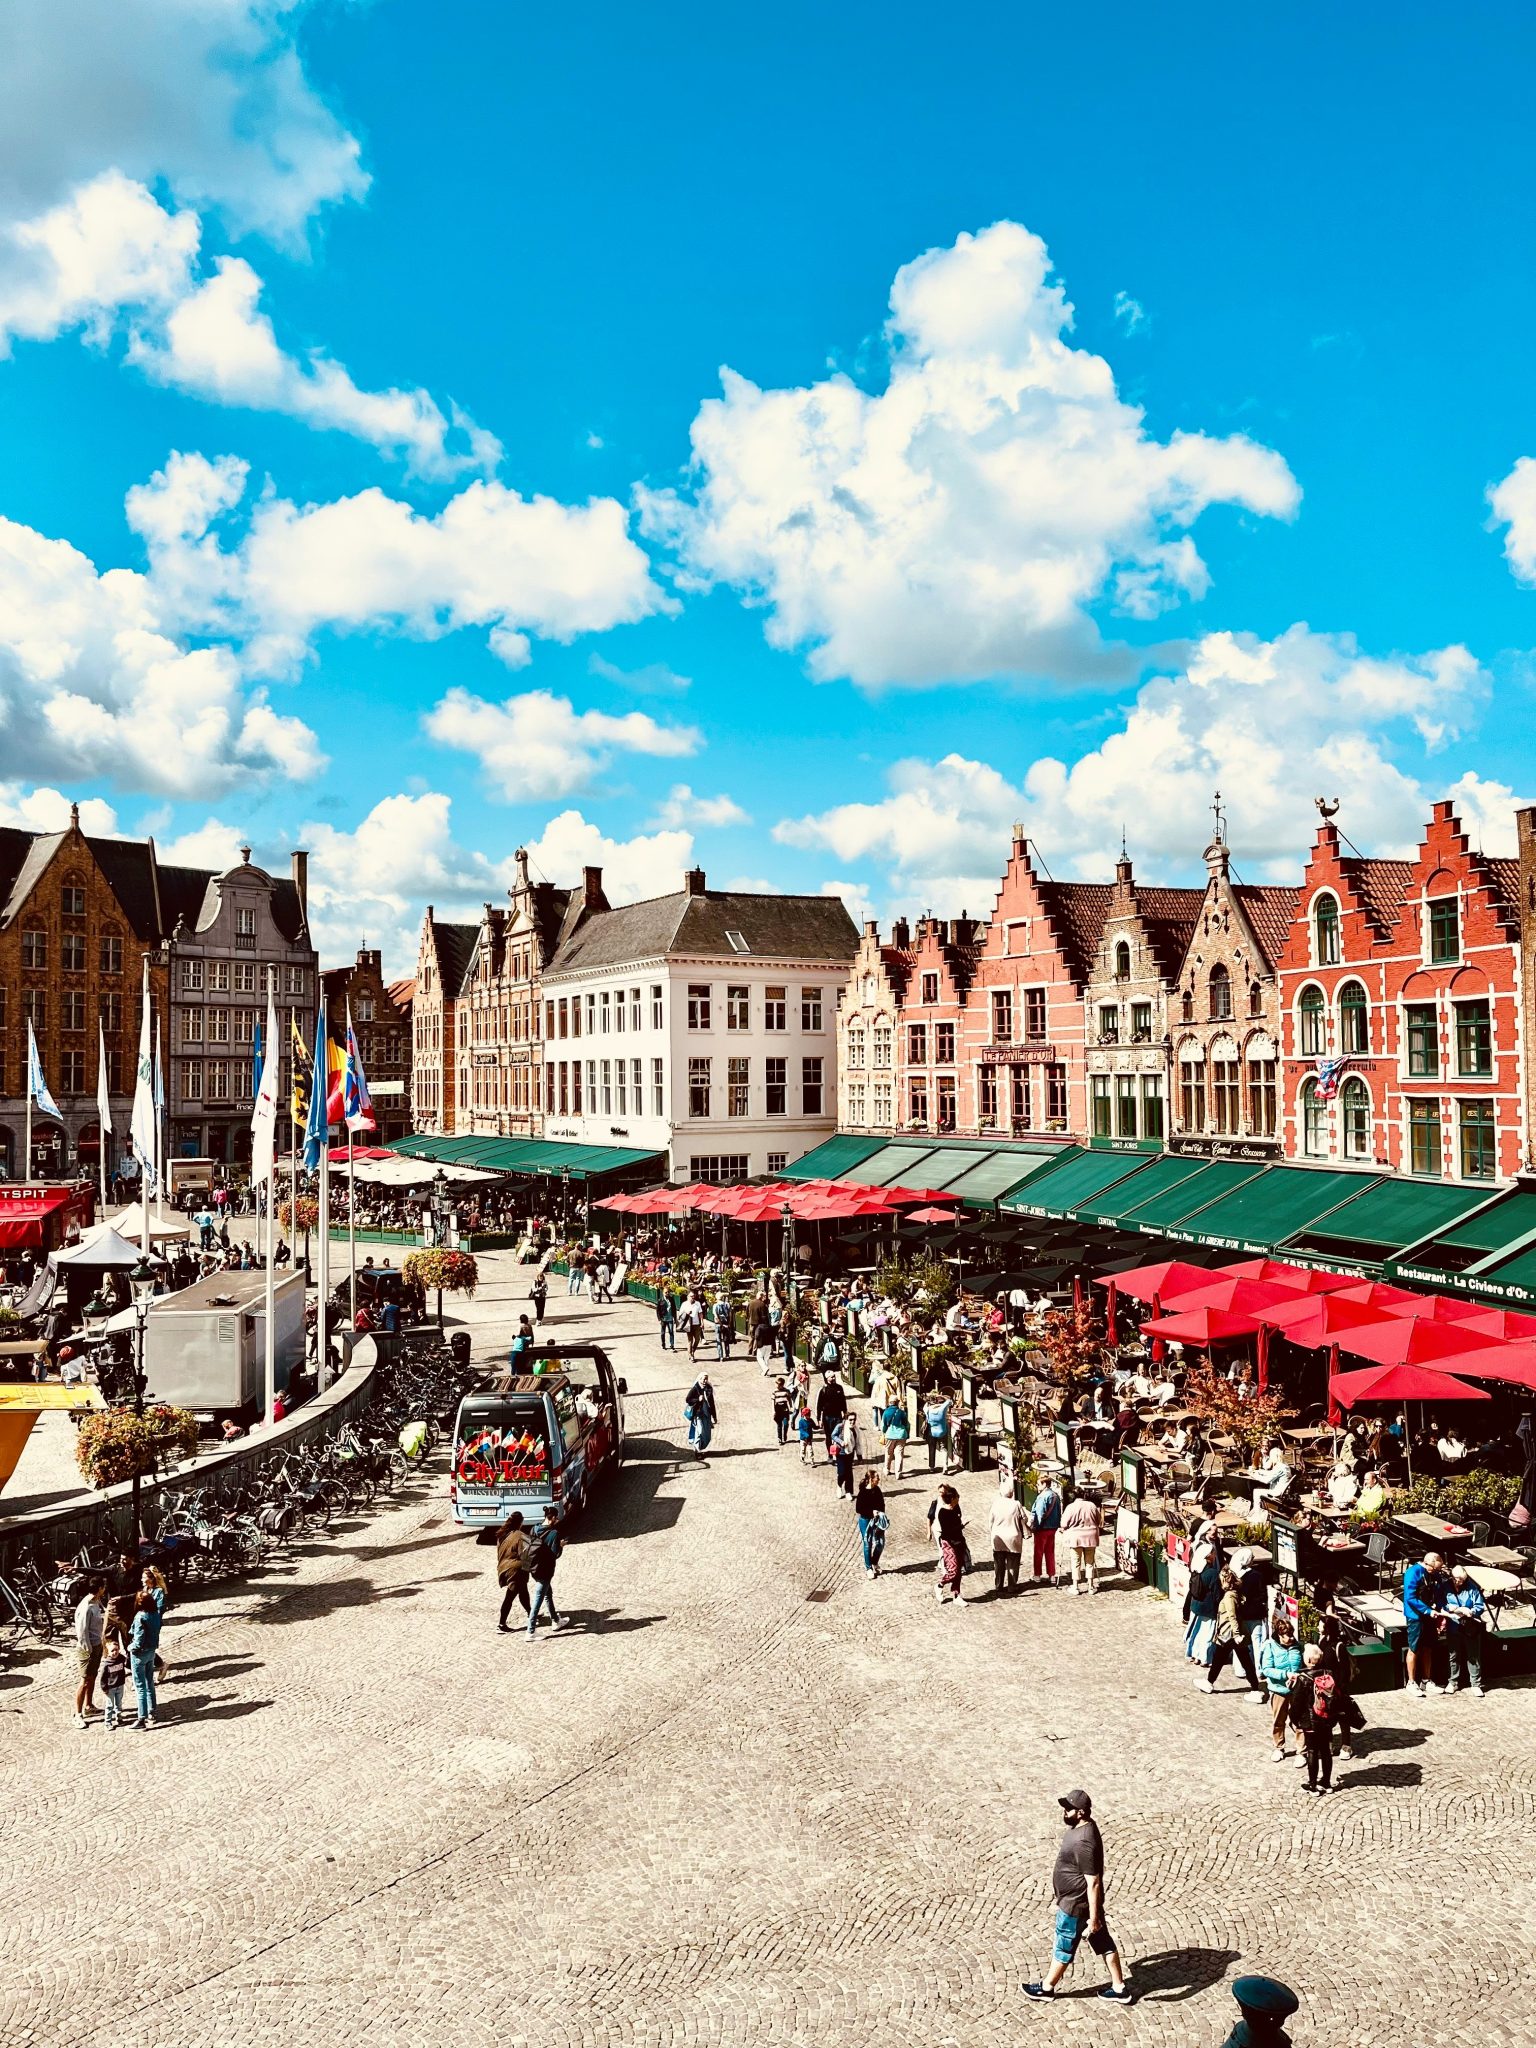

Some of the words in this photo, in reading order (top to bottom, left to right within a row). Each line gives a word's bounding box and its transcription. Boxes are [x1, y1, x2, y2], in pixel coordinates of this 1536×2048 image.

[236, 1103, 254, 1111] fnac
[1396, 1266, 1447, 1284] Restaurant
[1454, 1275, 1468, 1288] La
[1468, 1278, 1504, 1295] Civiere
[1506, 1286, 1529, 1299] d'Or
[459, 1460, 500, 1487] City
[499, 1460, 545, 1481] Tour
[509, 1487, 541, 1496] MARKT
